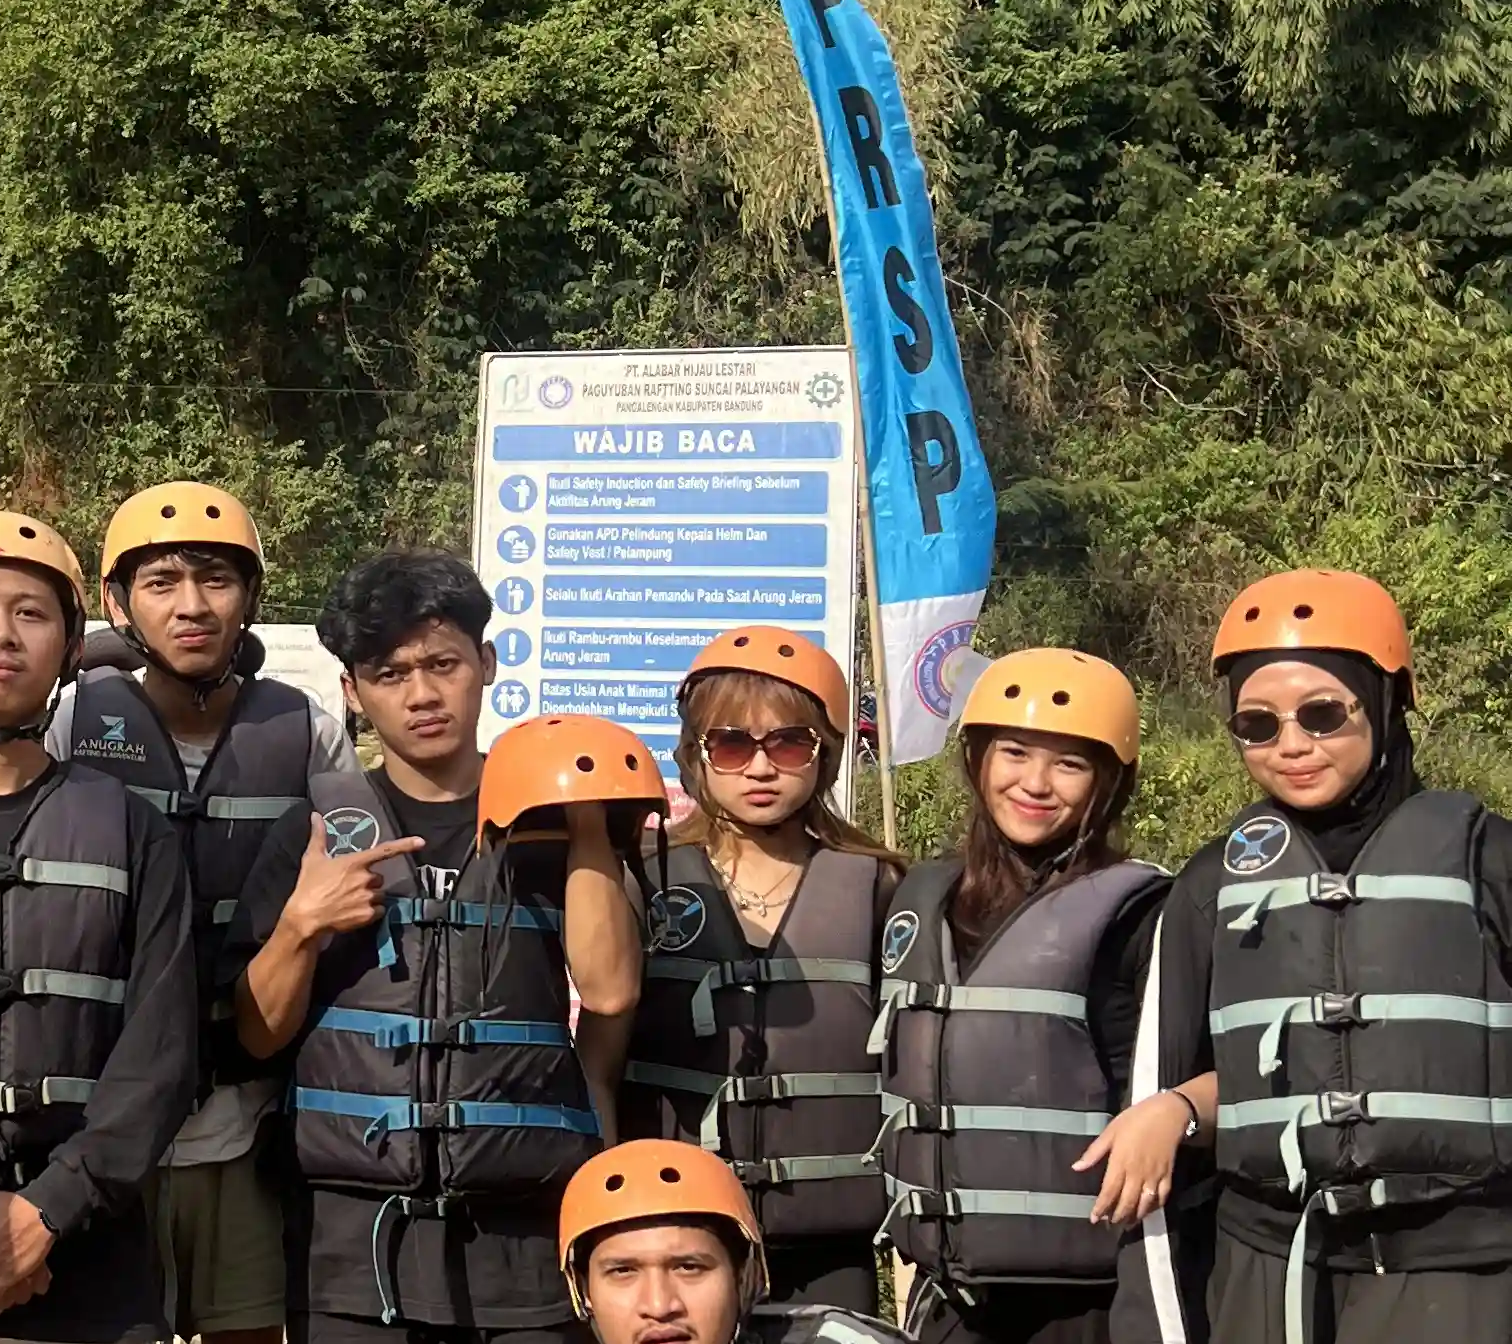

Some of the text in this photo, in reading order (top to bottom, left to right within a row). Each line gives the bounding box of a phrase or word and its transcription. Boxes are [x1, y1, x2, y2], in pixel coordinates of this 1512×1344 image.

[625, 362, 756, 377] PT. ALABAR HIJAU LESTARI
[582, 383, 640, 397] PAGUYUBAN
[735, 381, 800, 395] PALAYANGAN
[675, 400, 722, 412] KABUPATEN
[724, 400, 763, 412] BANDUNG
[573, 429, 756, 454] WAJIB BACA
[573, 476, 604, 492] Safety
[606, 477, 654, 490] Induction
[656, 477, 675, 489] dan
[677, 476, 709, 492] Safety
[712, 476, 752, 492] Briefing
[754, 475, 800, 489] Sebelum
[591, 494, 622, 510] Arung
[624, 494, 656, 507] Jeram
[548, 527, 768, 545] Gunakan APD Pelindung Kepala Helm Dan
[547, 545, 579, 561] Safety
[582, 545, 606, 559] Vest
[613, 545, 673, 562] Pelampung
[545, 587, 578, 601] Selalu
[605, 588, 643, 602] Arahan
[644, 588, 695, 602] Pemandu
[697, 588, 725, 603] Pada
[726, 588, 751, 603] Saat
[752, 589, 786, 606] Arung
[788, 589, 823, 604] Jeram
[569, 631, 642, 646] Rambu-rambu
[544, 649, 610, 665] Arung Jeram
[542, 682, 571, 696] Batas
[573, 683, 597, 696] Usia
[599, 683, 625, 697] Anak
[627, 684, 667, 698] Minimal
[618, 702, 668, 719] Mengikuti
[78, 738, 145, 755] ANUGRAH
